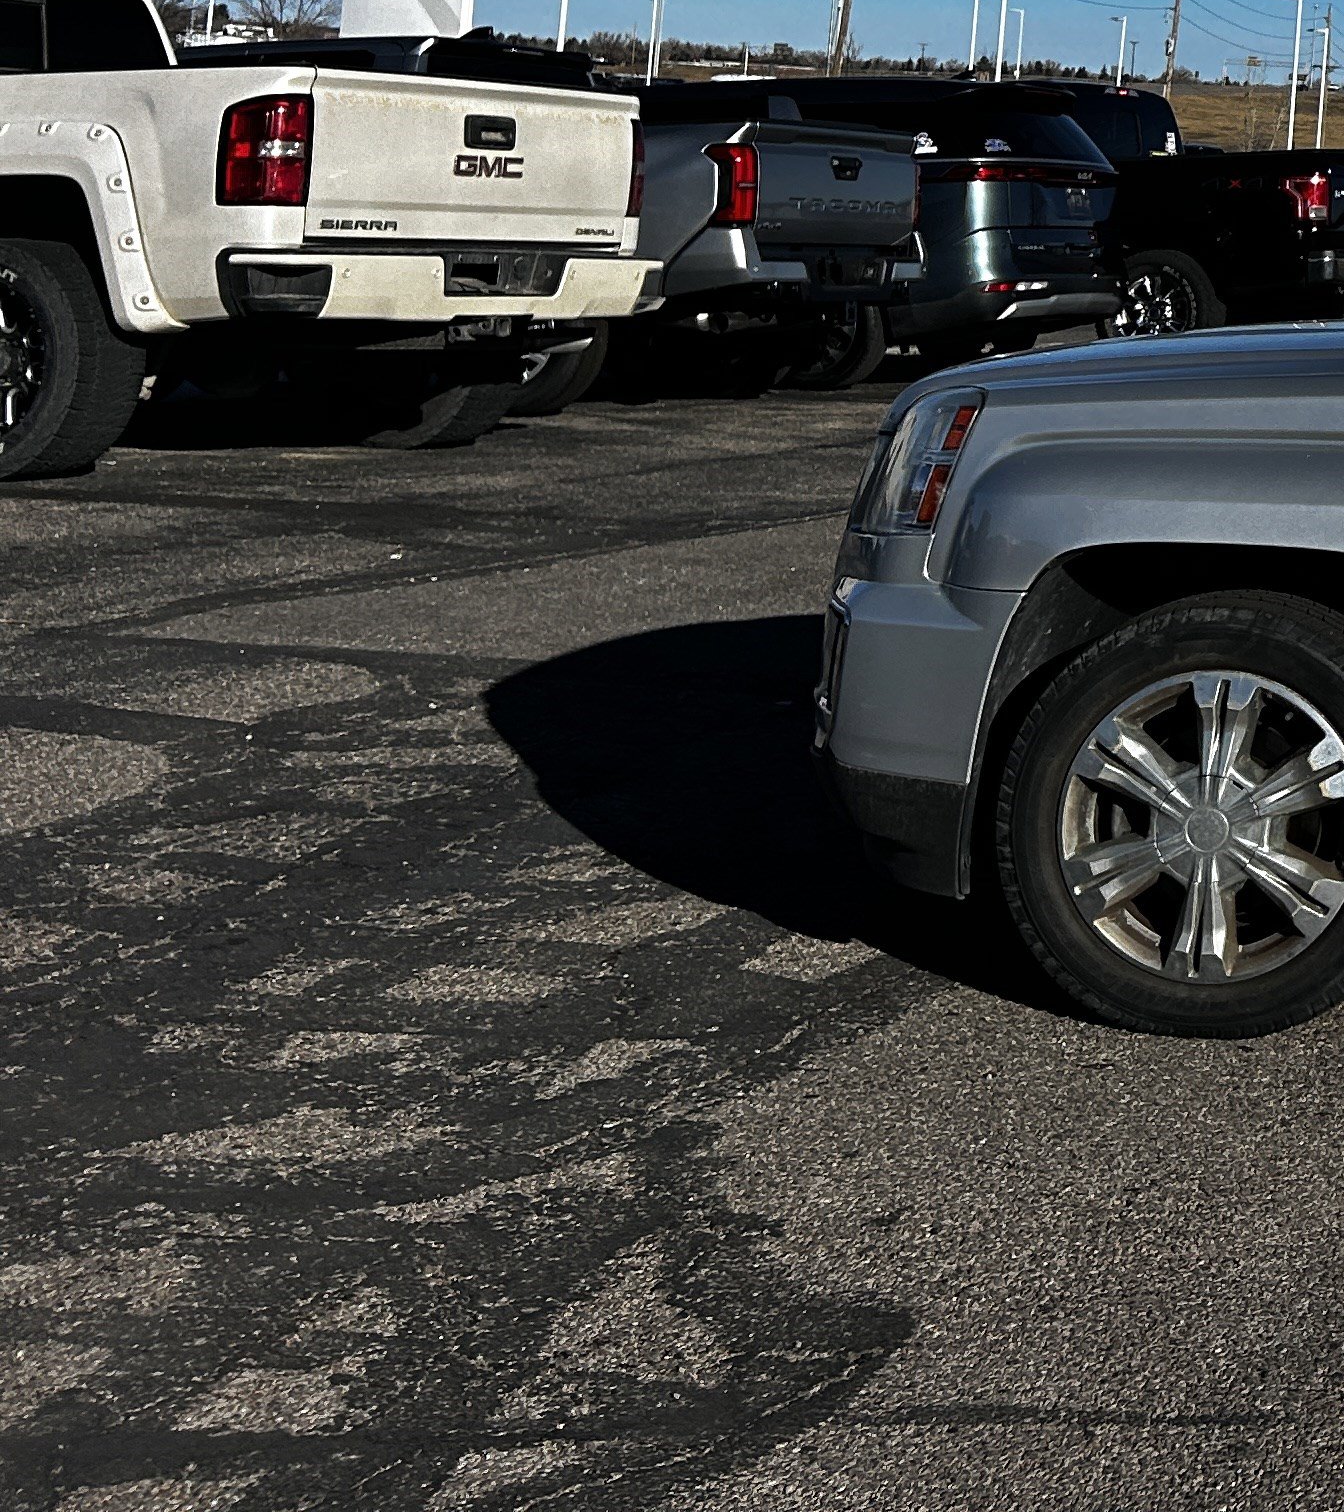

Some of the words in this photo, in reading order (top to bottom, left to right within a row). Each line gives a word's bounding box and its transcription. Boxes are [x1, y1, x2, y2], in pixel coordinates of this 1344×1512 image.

[453, 154, 525, 178] GMC
[789, 197, 897, 215] TACOMA
[320, 219, 398, 231] SIERRA
